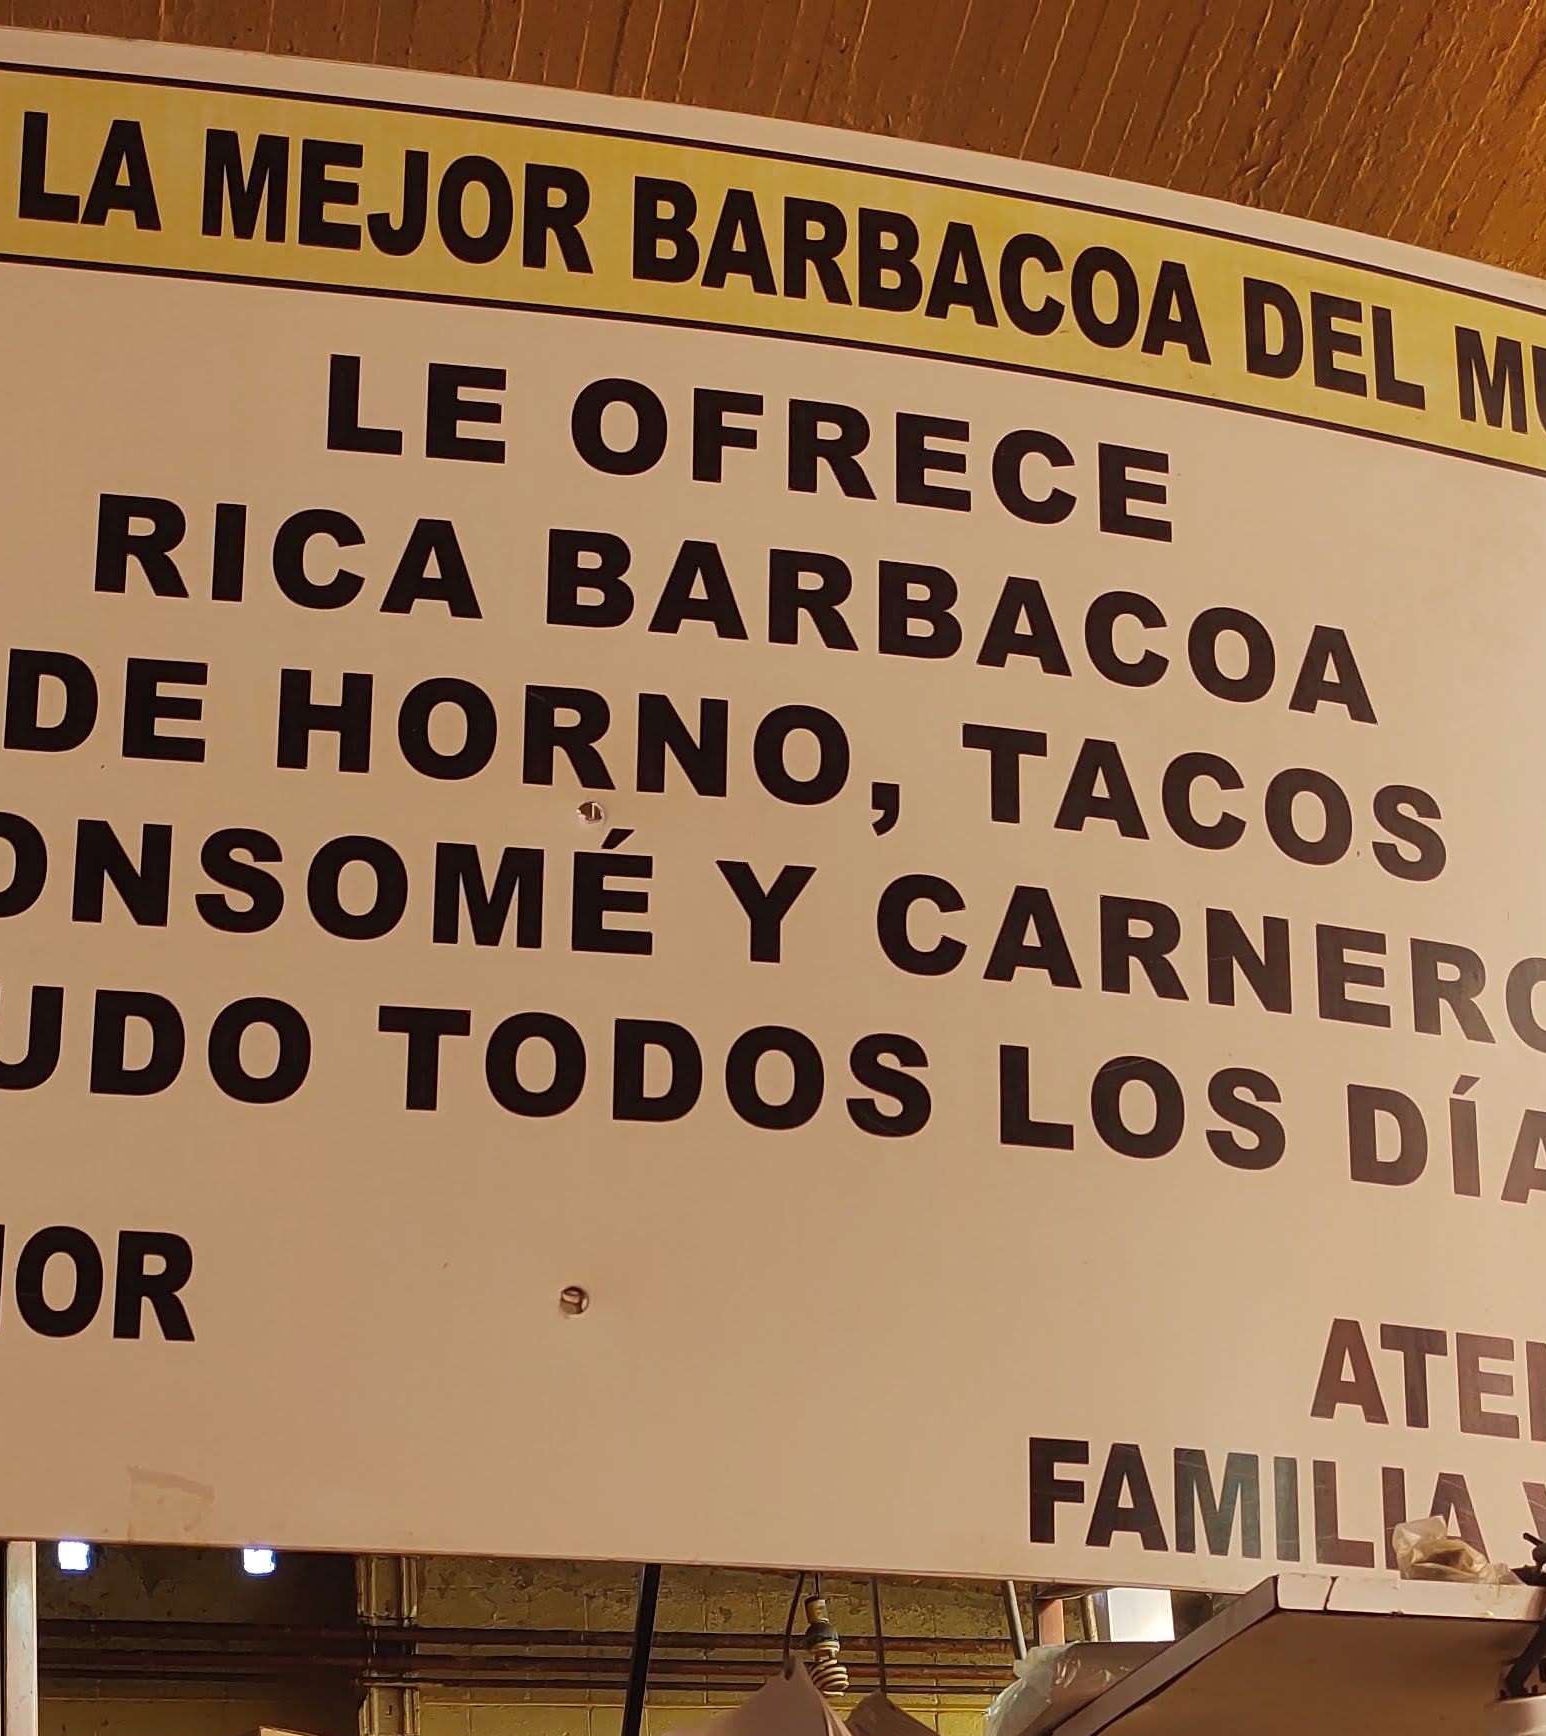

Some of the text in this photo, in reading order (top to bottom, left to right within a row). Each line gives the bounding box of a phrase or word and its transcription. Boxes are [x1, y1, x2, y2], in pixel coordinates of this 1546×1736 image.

[19, 111, 162, 232] LA
[202, 128, 593, 274] MEJOR
[633, 176, 1212, 366] BARBACOA
[1243, 277, 1426, 410] DEL
[327, 354, 1173, 542] LE OFRECE
[95, 493, 1378, 725] RICA BARBACOA
[4, 648, 1446, 881] DE HORNO, TACOS
[715, 860, 817, 963] Y
[378, 1005, 931, 1137] TODOS
[1000, 1044, 1286, 1170] LOS
[1029, 1437, 1491, 1577] FAMILIA
